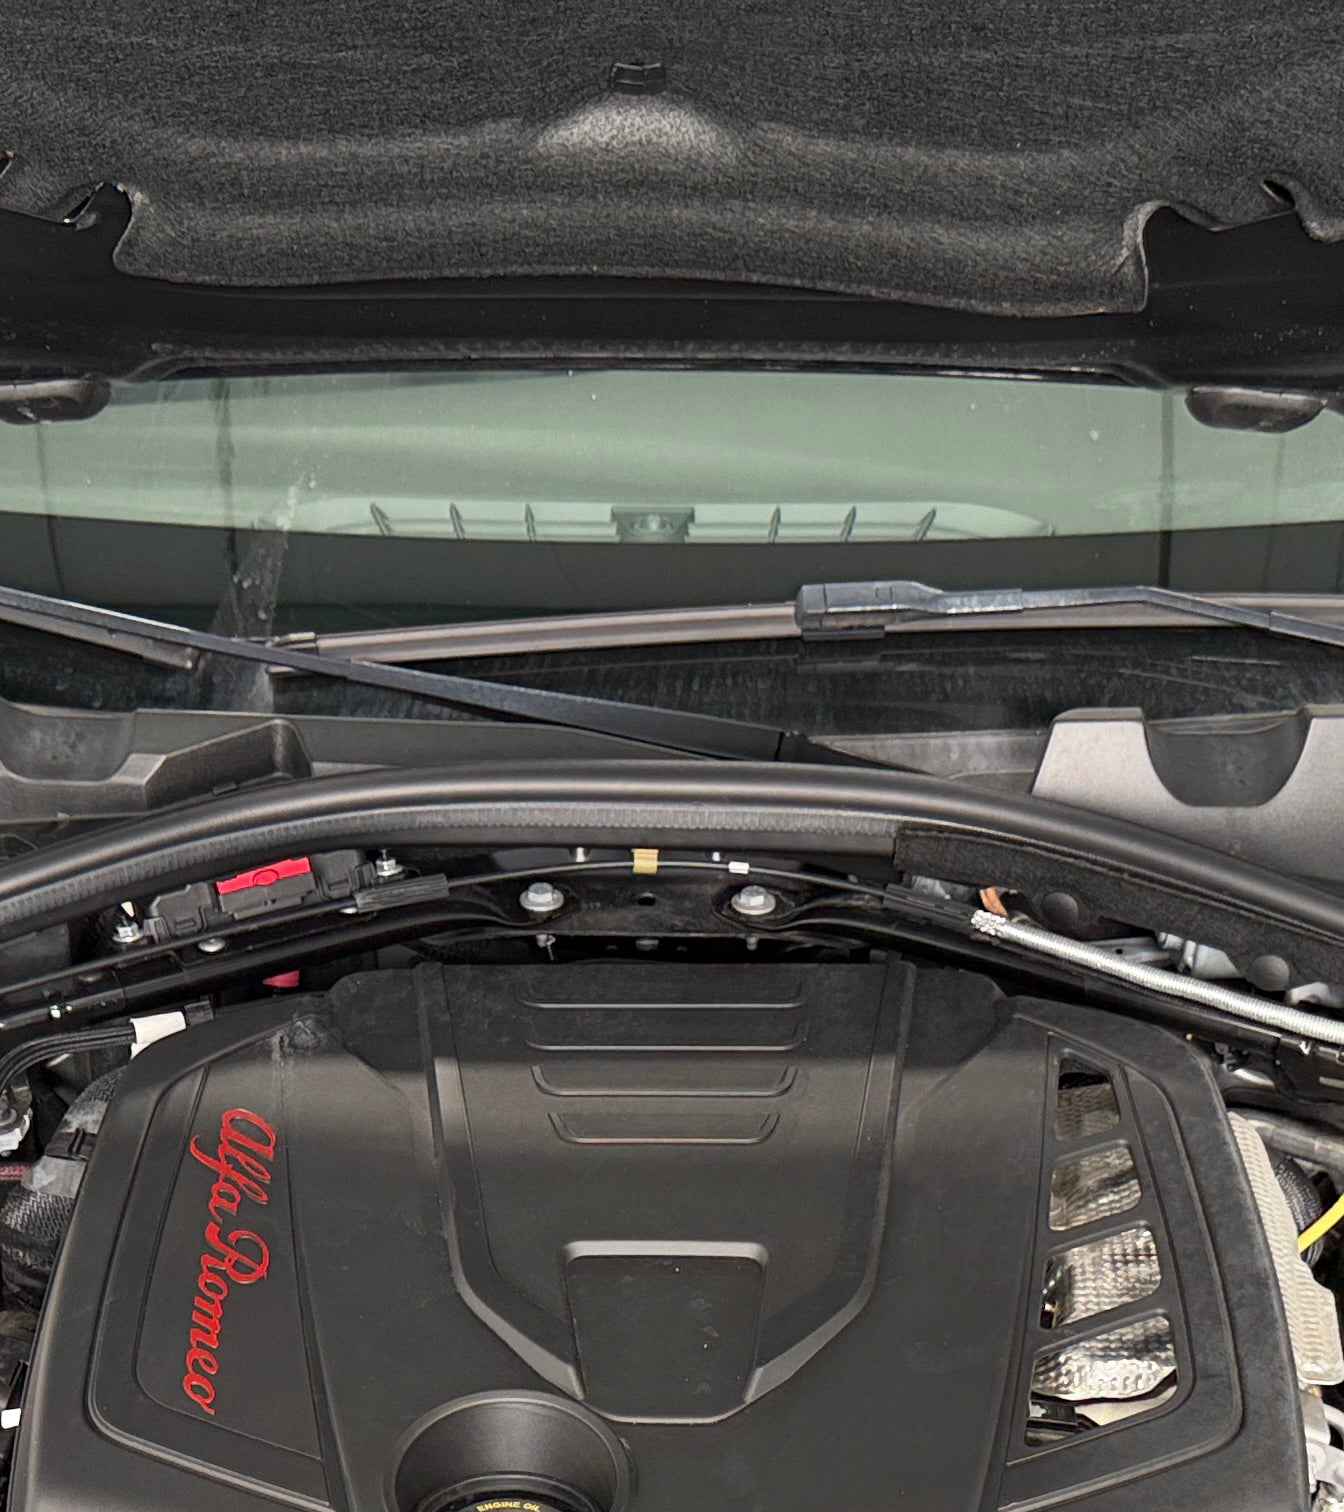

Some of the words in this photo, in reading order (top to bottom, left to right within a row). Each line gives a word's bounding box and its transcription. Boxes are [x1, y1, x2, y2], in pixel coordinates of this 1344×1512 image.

[189, 1107, 277, 1224] Alfa
[183, 1221, 270, 1416] Romeo
[476, 1501, 521, 1512] ENGINE
[523, 1502, 540, 1512] OIL
